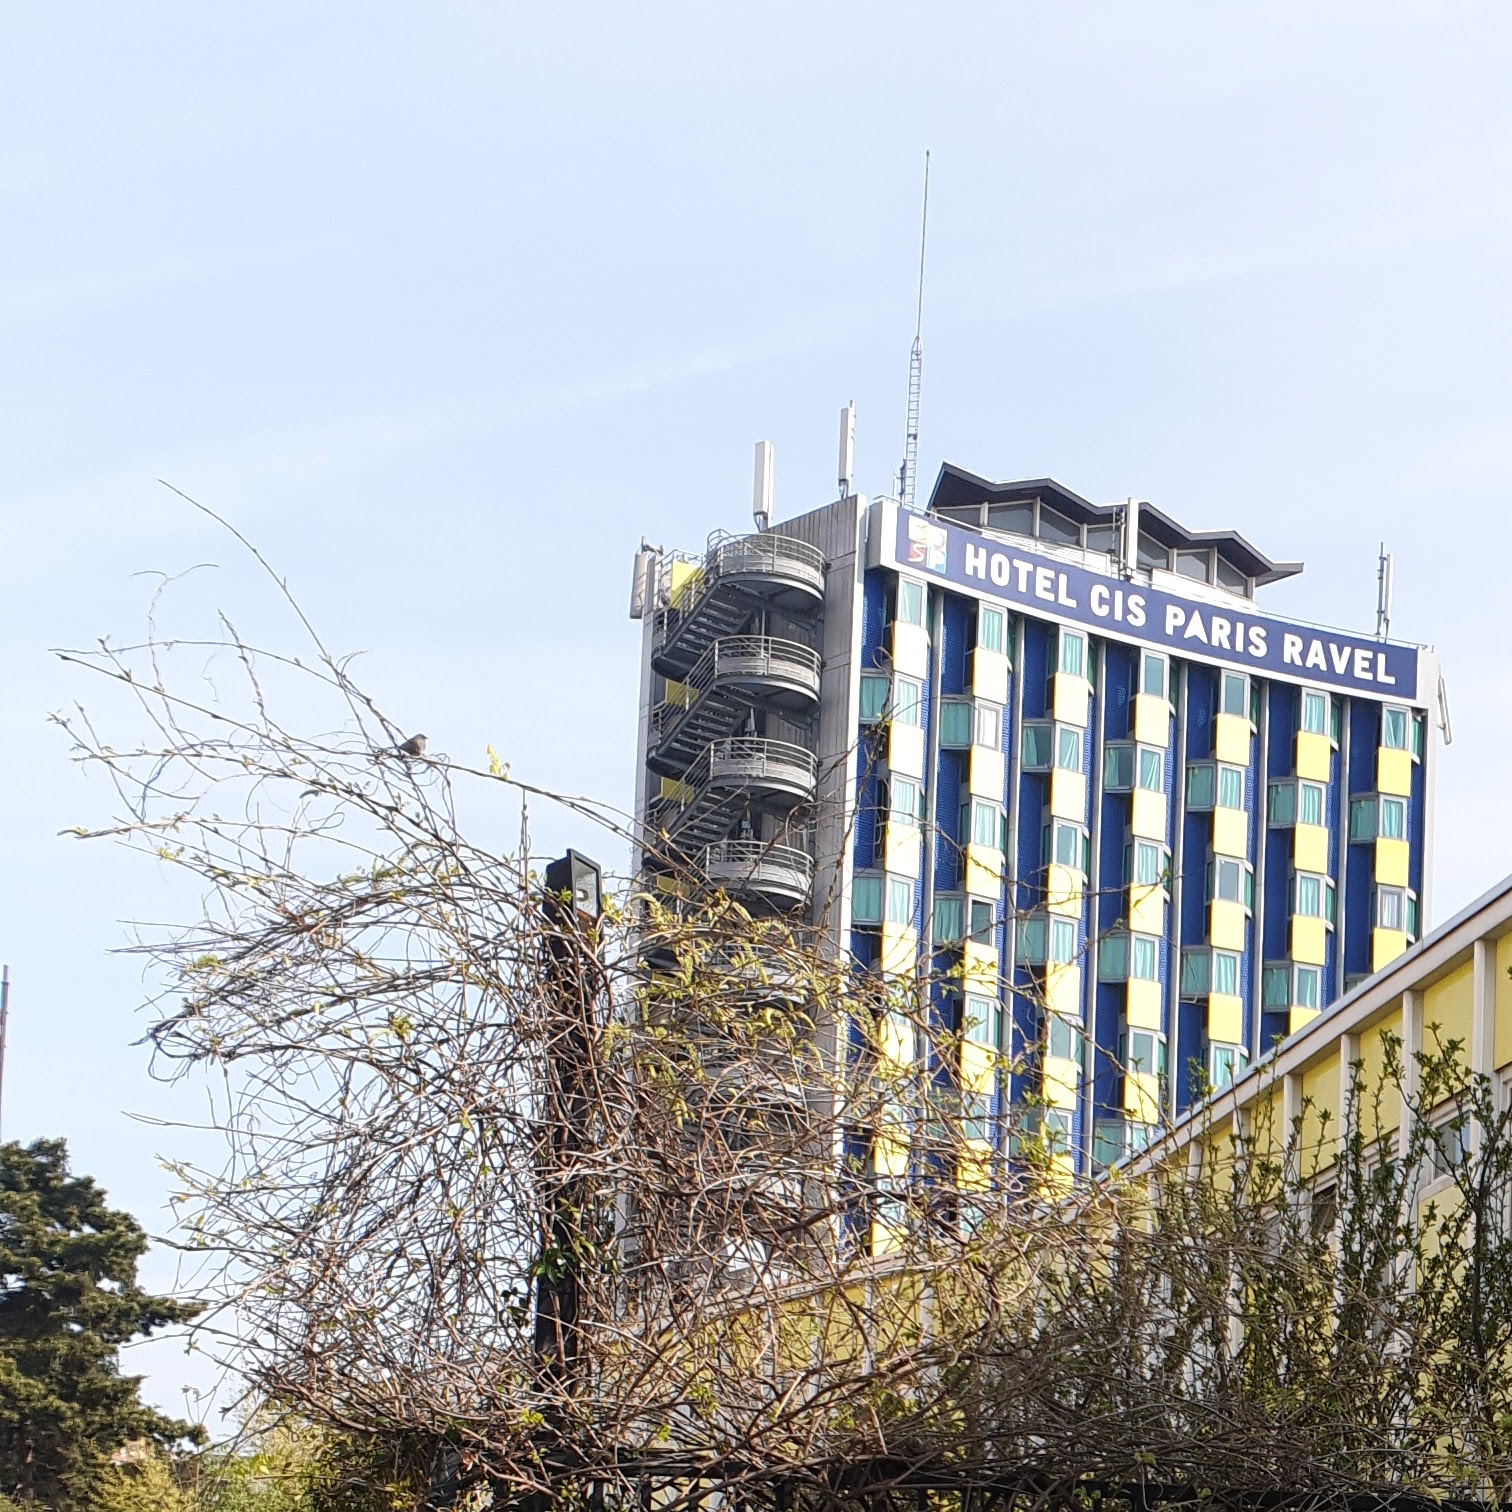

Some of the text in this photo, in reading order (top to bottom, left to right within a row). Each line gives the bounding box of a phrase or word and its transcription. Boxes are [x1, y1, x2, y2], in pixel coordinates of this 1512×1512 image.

[964, 542, 1396, 685] HOTEL CIS PARIS RAVEL
